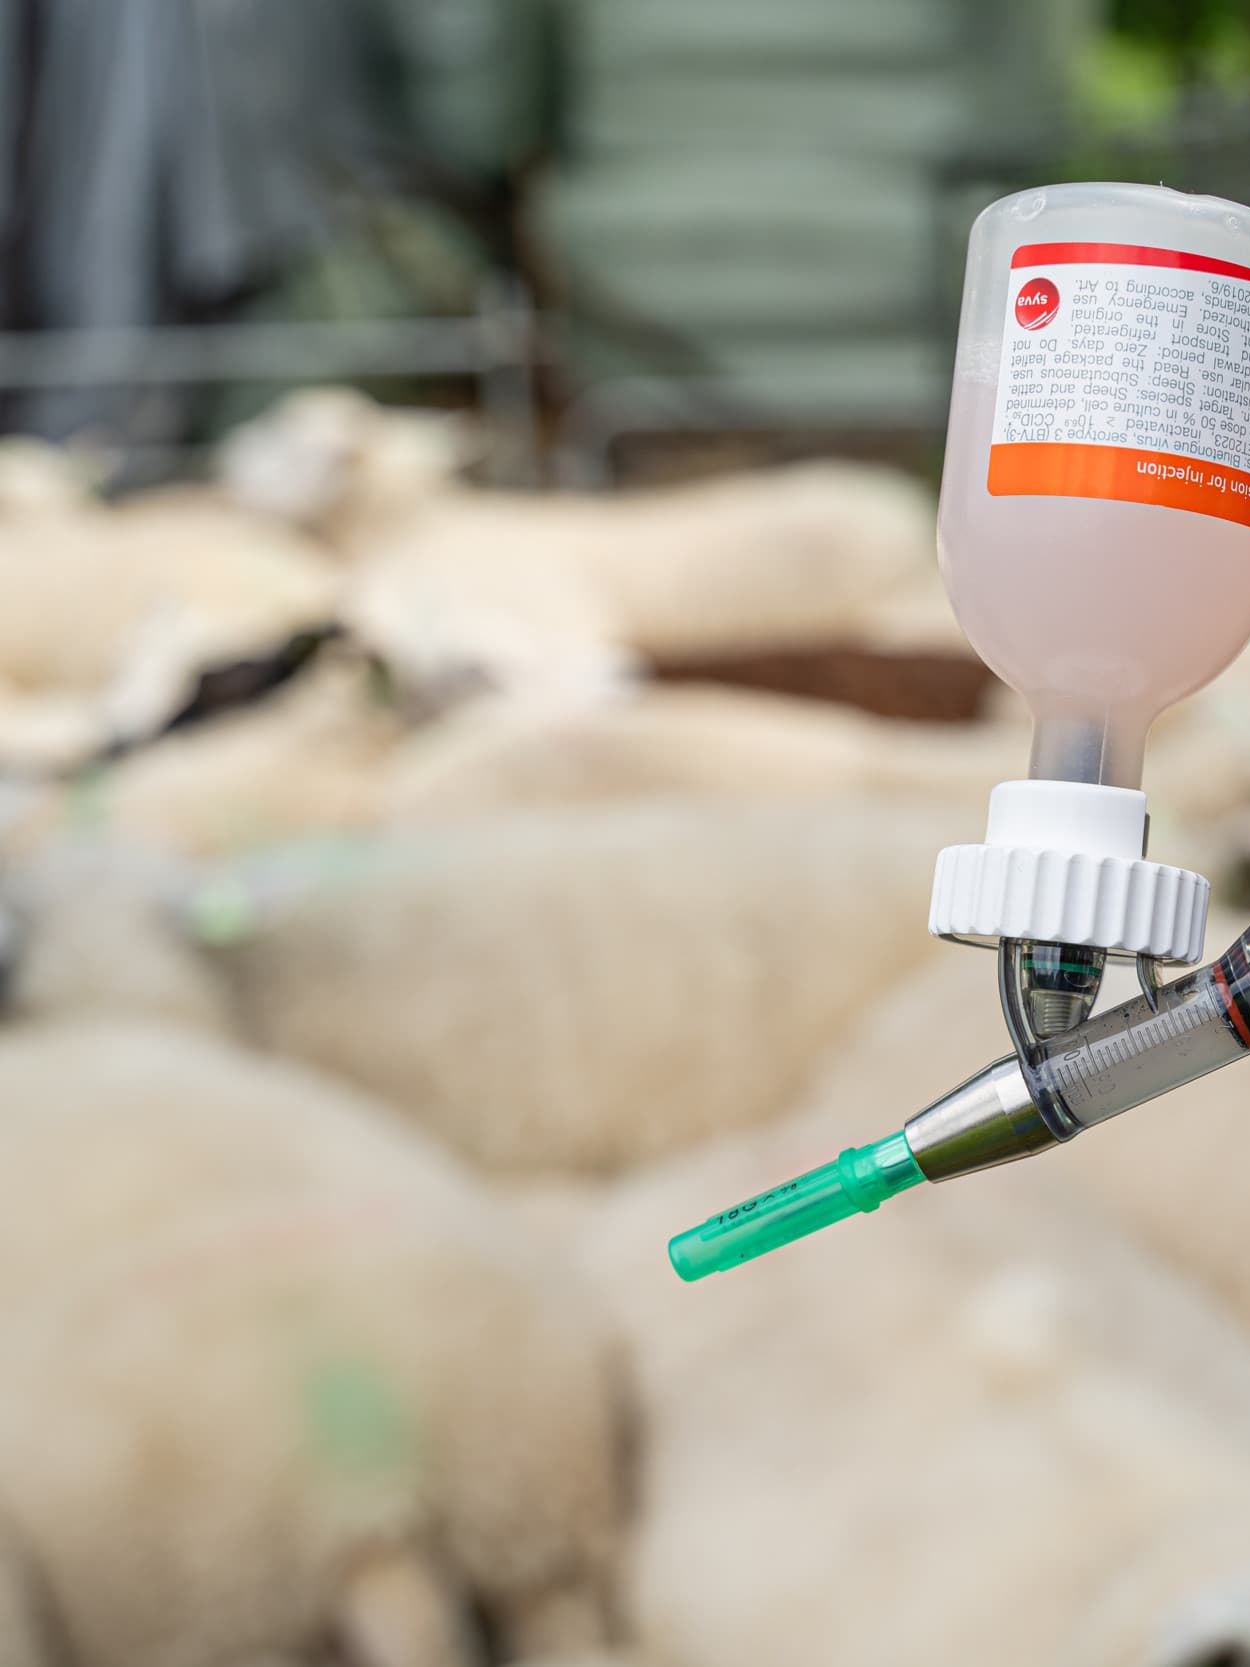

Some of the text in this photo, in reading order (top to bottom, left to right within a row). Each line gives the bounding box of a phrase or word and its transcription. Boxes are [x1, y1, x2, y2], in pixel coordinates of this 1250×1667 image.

[1075, 279, 1099, 294] Art.
[1105, 280, 1119, 293] to
[1126, 280, 1195, 302] according
[1018, 292, 1048, 306] syva
[1072, 294, 1098, 306] use
[1108, 294, 1188, 318] Emergency
[1071, 308, 1123, 322] original
[1136, 314, 1158, 328] the
[1071, 324, 1156, 342] refrigerated.
[1172, 319, 1184, 332] in
[1196, 323, 1230, 343] Store
[1012, 340, 1031, 353] not
[1039, 339, 1057, 352] Do
[1114, 342, 1148, 357] Zero
[1171, 334, 1230, 357] transport
[1011, 354, 1046, 367] leaflet
[1054, 350, 1113, 367] package
[1157, 346, 1205, 364] period:
[1122, 358, 1144, 372] the
[1153, 361, 1189, 379] Read
[1010, 369, 1033, 380] use.
[1040, 369, 1139, 387] Subcutaneous
[1198, 369, 1224, 384] use.
[1008, 383, 1043, 397] cattle.
[1050, 384, 1075, 396] and
[1082, 382, 1128, 401] Sheep
[1148, 374, 1195, 397] Sheep:
[1006, 399, 1076, 413] determined
[1081, 398, 1108, 412] cell,
[1136, 389, 1192, 408] species:
[1112, 402, 1161, 418] culture
[1166, 409, 1177, 423] in
[1199, 400, 1234, 420] Target
[1201, 415, 1216, 430] 50
[1220, 420, 1247, 438] dose
[1054, 428, 1063, 441] 3
[1068, 426, 1127, 444] serotype
[1126, 419, 1201, 442] inactivated
[1133, 432, 1169, 450] virus,
[1174, 441, 1240, 468] Bluetongue
[1137, 461, 1203, 488] injection
[1206, 474, 1226, 493] for
